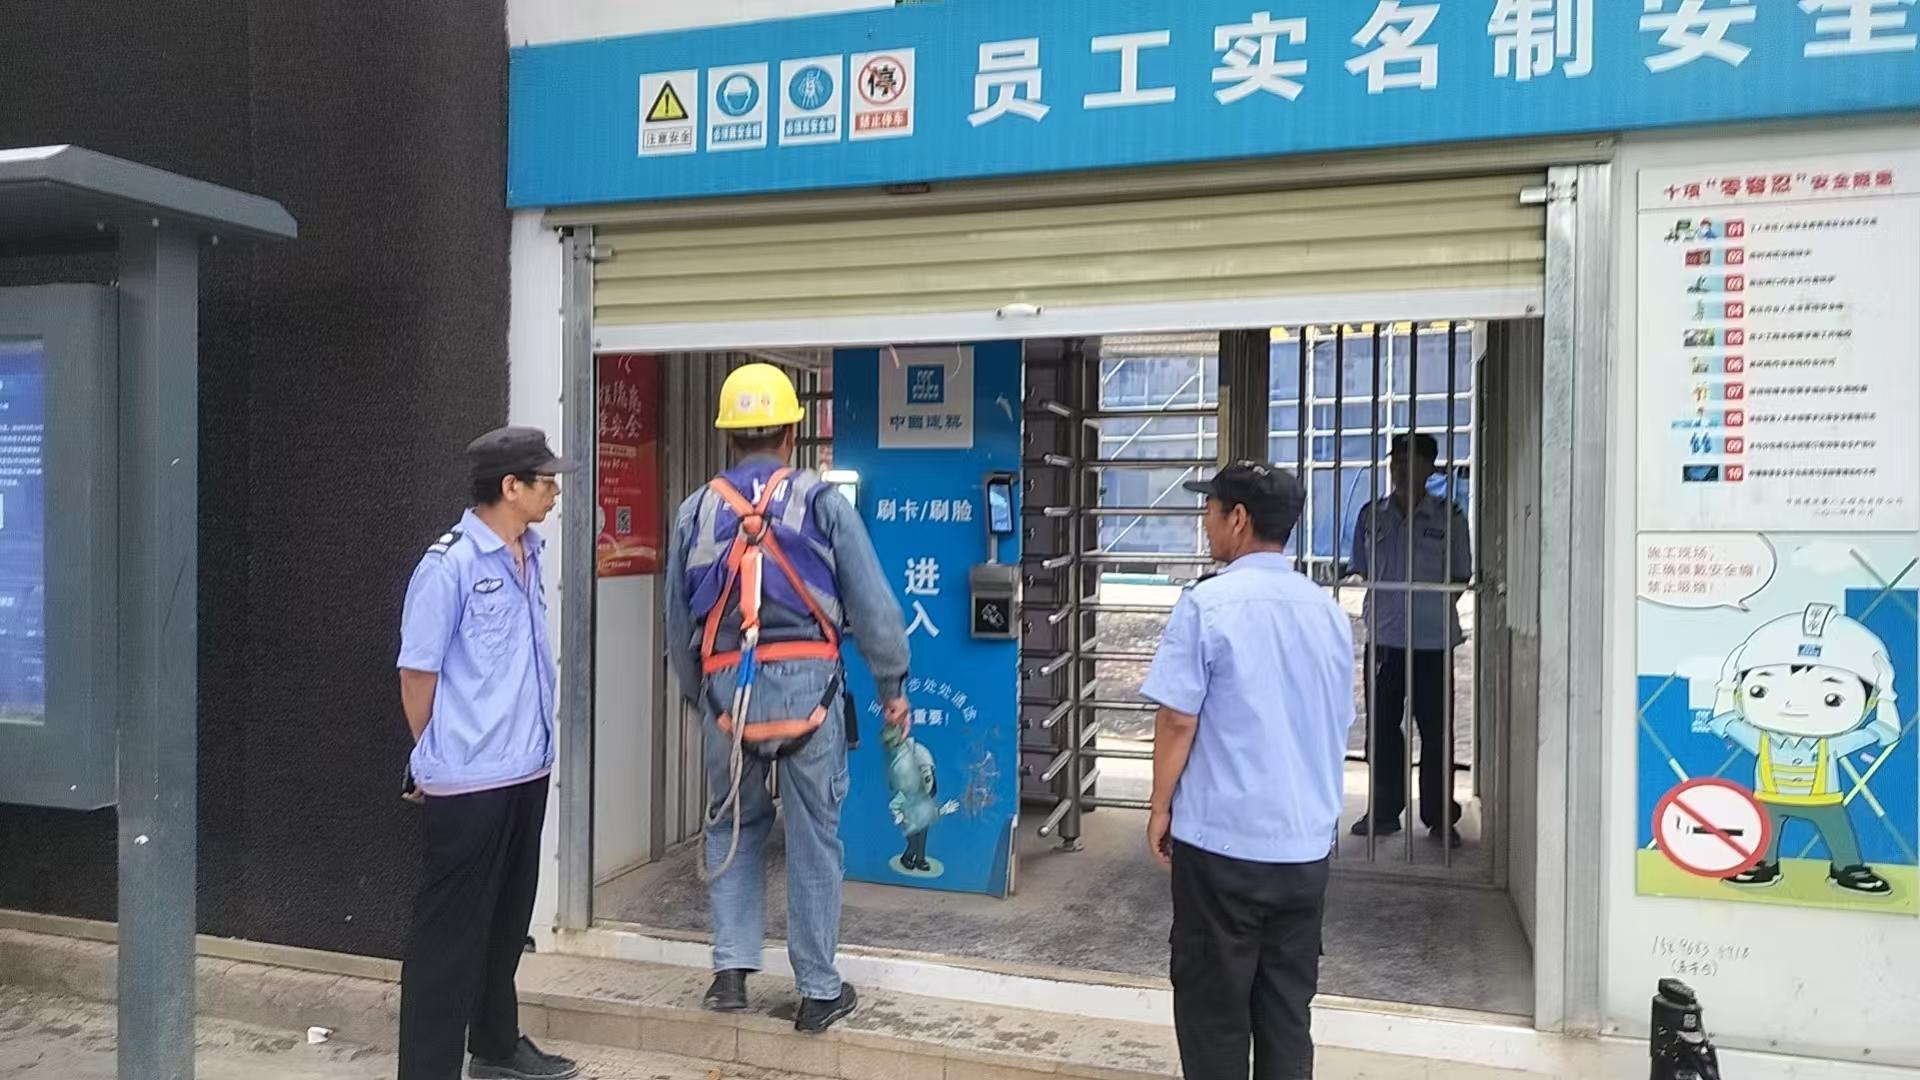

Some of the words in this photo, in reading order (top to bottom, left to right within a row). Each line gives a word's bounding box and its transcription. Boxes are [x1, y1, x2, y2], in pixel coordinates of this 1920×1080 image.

[860, 112, 905, 129] 禁止停车
[647, 131, 691, 145] 注意安全
[1727, 222, 1743, 236] 01
[1727, 305, 1743, 319] 04
[1727, 386, 1743, 399] 07
[1727, 466, 1743, 480] 10
[877, 498, 972, 523] 刷卡/刷脸
[1647, 580, 1714, 594] 禁止吸烟！
[904, 556, 940, 638] 进入
